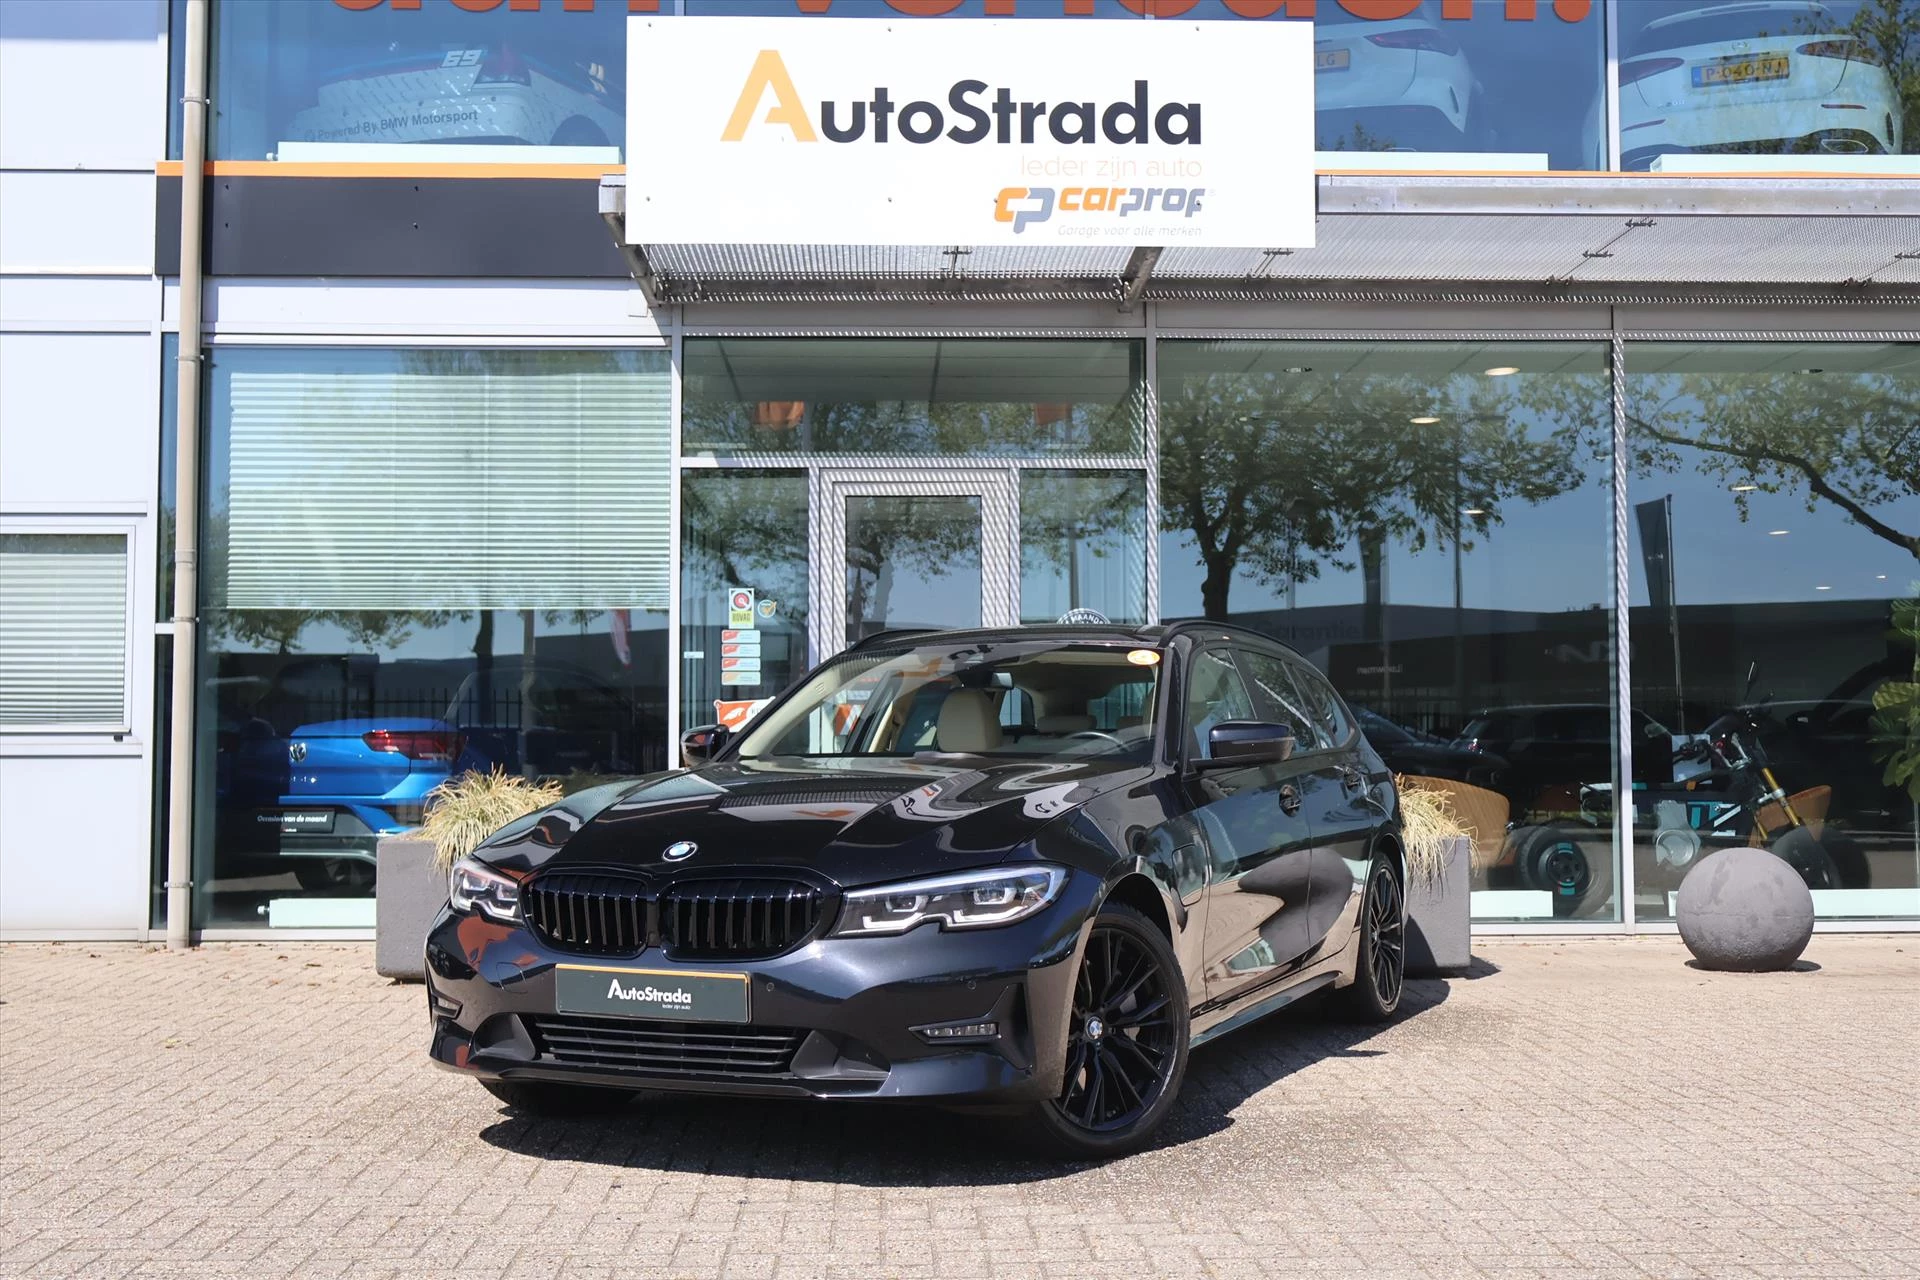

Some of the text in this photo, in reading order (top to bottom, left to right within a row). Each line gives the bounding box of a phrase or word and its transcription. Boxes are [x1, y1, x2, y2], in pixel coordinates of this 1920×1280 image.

[441, 49, 482, 67] 69
[721, 50, 1201, 145] AutoStrada
[318, 110, 478, 139] Powered By BMW Motorsport
[1021, 156, 1203, 180] Ieder zijn auto
[1058, 225, 1203, 238] Garage voor alle merken
[607, 978, 692, 1003] AutoStrada
